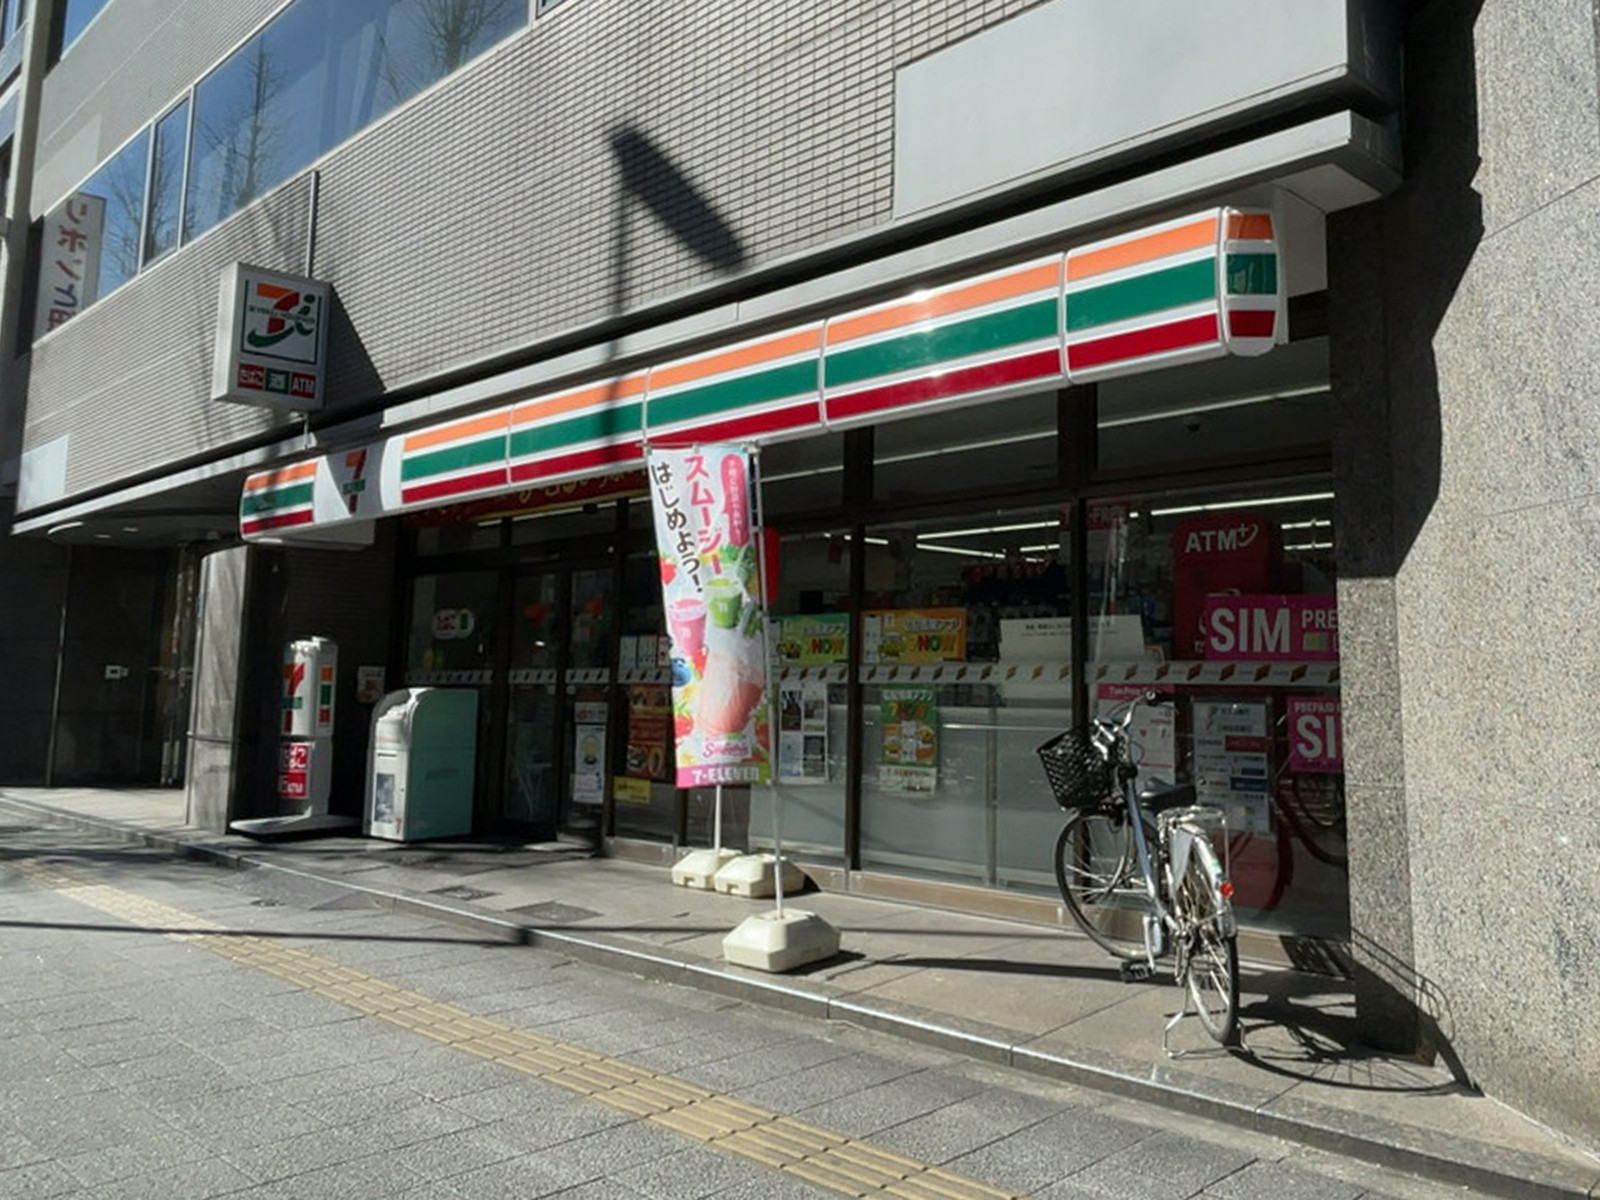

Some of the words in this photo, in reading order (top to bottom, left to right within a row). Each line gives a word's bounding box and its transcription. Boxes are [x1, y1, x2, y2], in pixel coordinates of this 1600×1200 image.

[291, 378, 315, 393] ATM
[684, 453, 723, 576] スムージー
[1210, 607, 1291, 654] SIM
[1293, 701, 1335, 713] PREPAID
